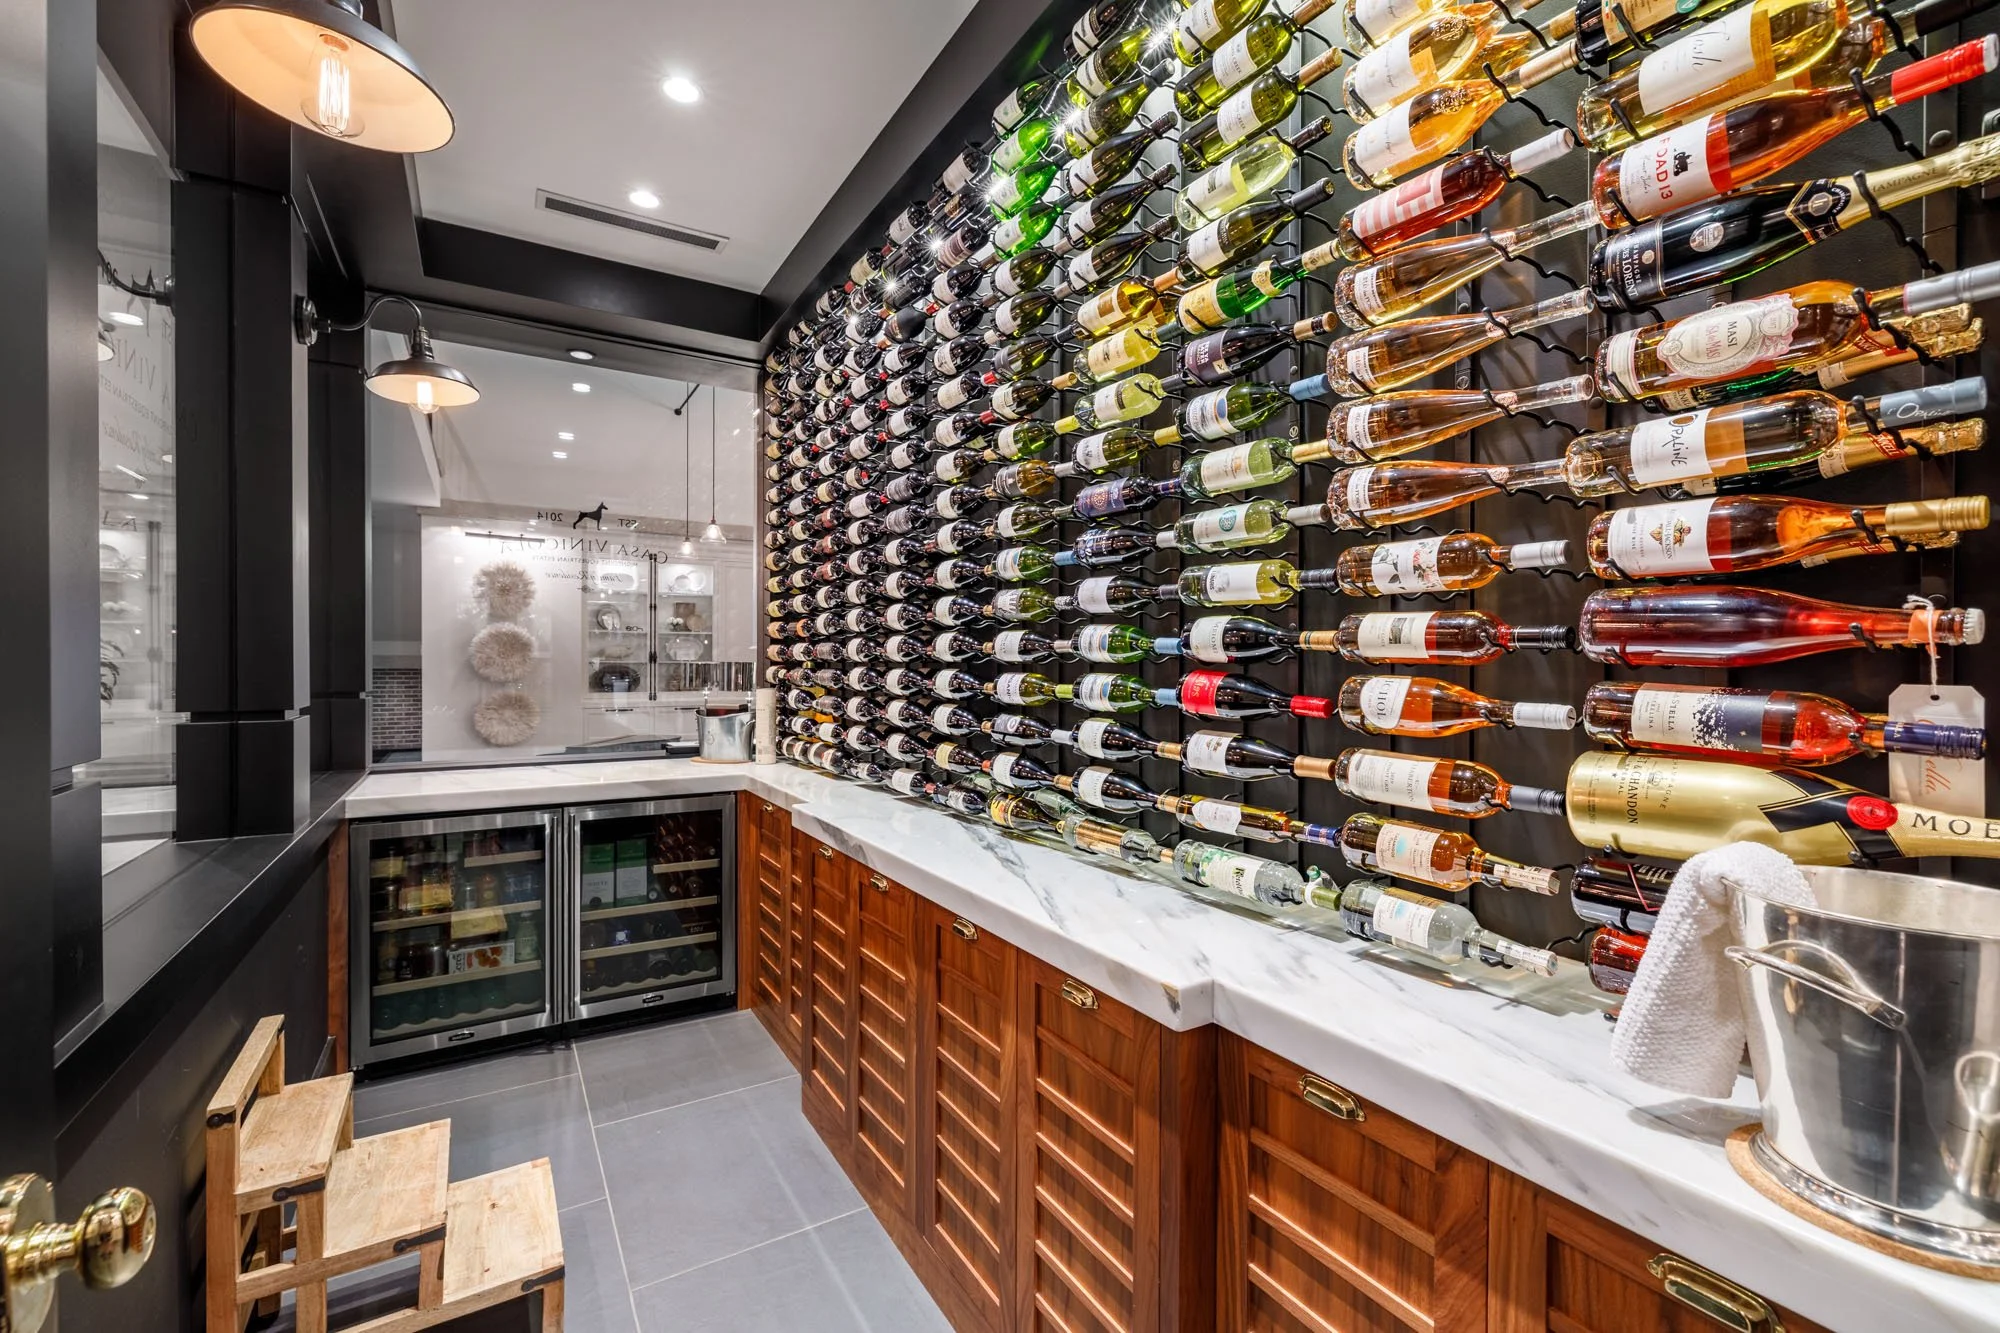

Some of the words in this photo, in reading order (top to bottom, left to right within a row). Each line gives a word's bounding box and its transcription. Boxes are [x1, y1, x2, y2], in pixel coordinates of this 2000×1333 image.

[1659, 184, 1673, 200] 13
[1622, 259, 1639, 297] LORENT
[1727, 320, 1738, 347] MASI
[1376, 680, 1395, 720] ICHOL
[1667, 700, 1680, 731] STELLA
[1626, 770, 1641, 825] CHANDON
